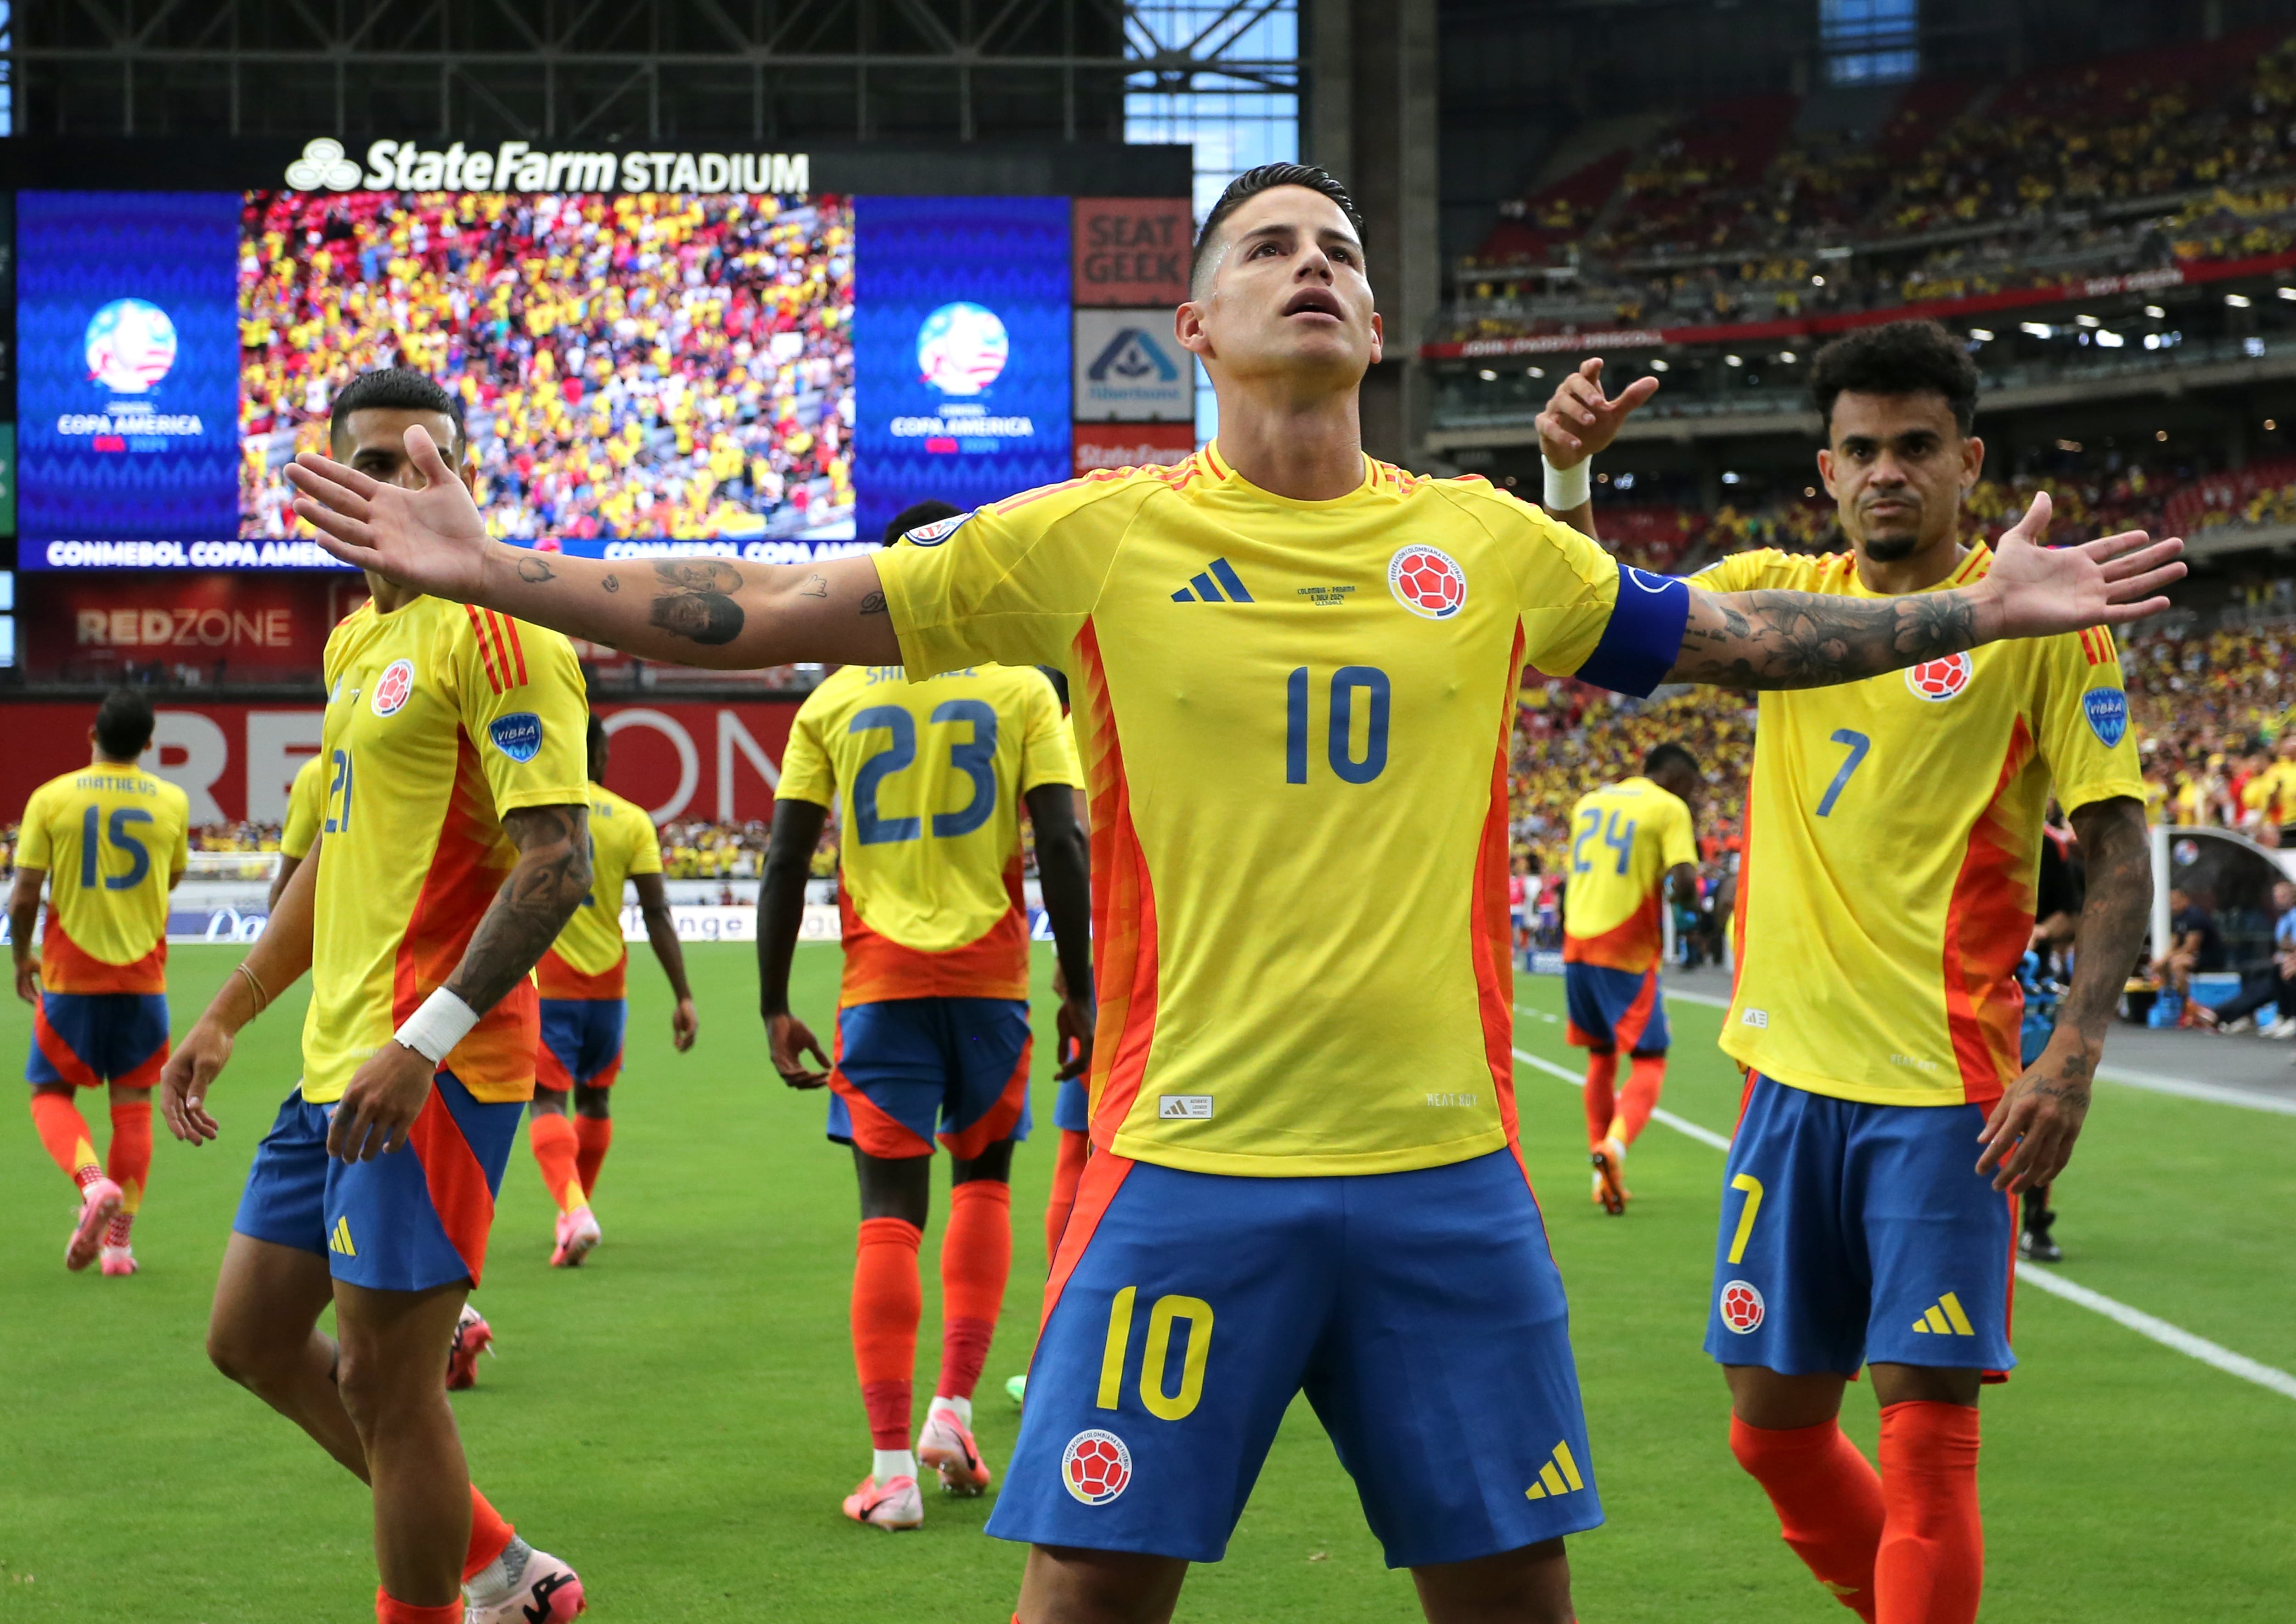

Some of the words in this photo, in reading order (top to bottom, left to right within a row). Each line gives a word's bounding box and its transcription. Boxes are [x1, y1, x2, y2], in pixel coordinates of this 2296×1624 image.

[621, 152, 810, 193] STADIUM
[1089, 215, 1176, 247] SEAT
[1084, 252, 1181, 284] GEEK
[57, 414, 113, 435] COPA
[113, 414, 204, 435] AMERICA
[890, 417, 944, 437] COPA
[46, 541, 188, 567] CONMEBOL
[189, 541, 258, 567] COPA
[258, 541, 356, 567] AMER
[743, 541, 812, 565] COPA
[77, 609, 292, 647] REDZONE
[498, 725, 535, 741] VIBRA
[1287, 666, 1390, 784] 10
[77, 776, 157, 796] MATHEUS
[325, 748, 353, 833] 21
[848, 699, 997, 845] 23
[1815, 728, 1870, 817] 7
[81, 803, 154, 891] 15
[1574, 807, 1636, 876] 24
[1425, 1093, 1454, 1106] HEAT
[1459, 1094, 1477, 1106] RDY
[1727, 1173, 1764, 1264] 7
[1096, 1286, 1214, 1421] 10
